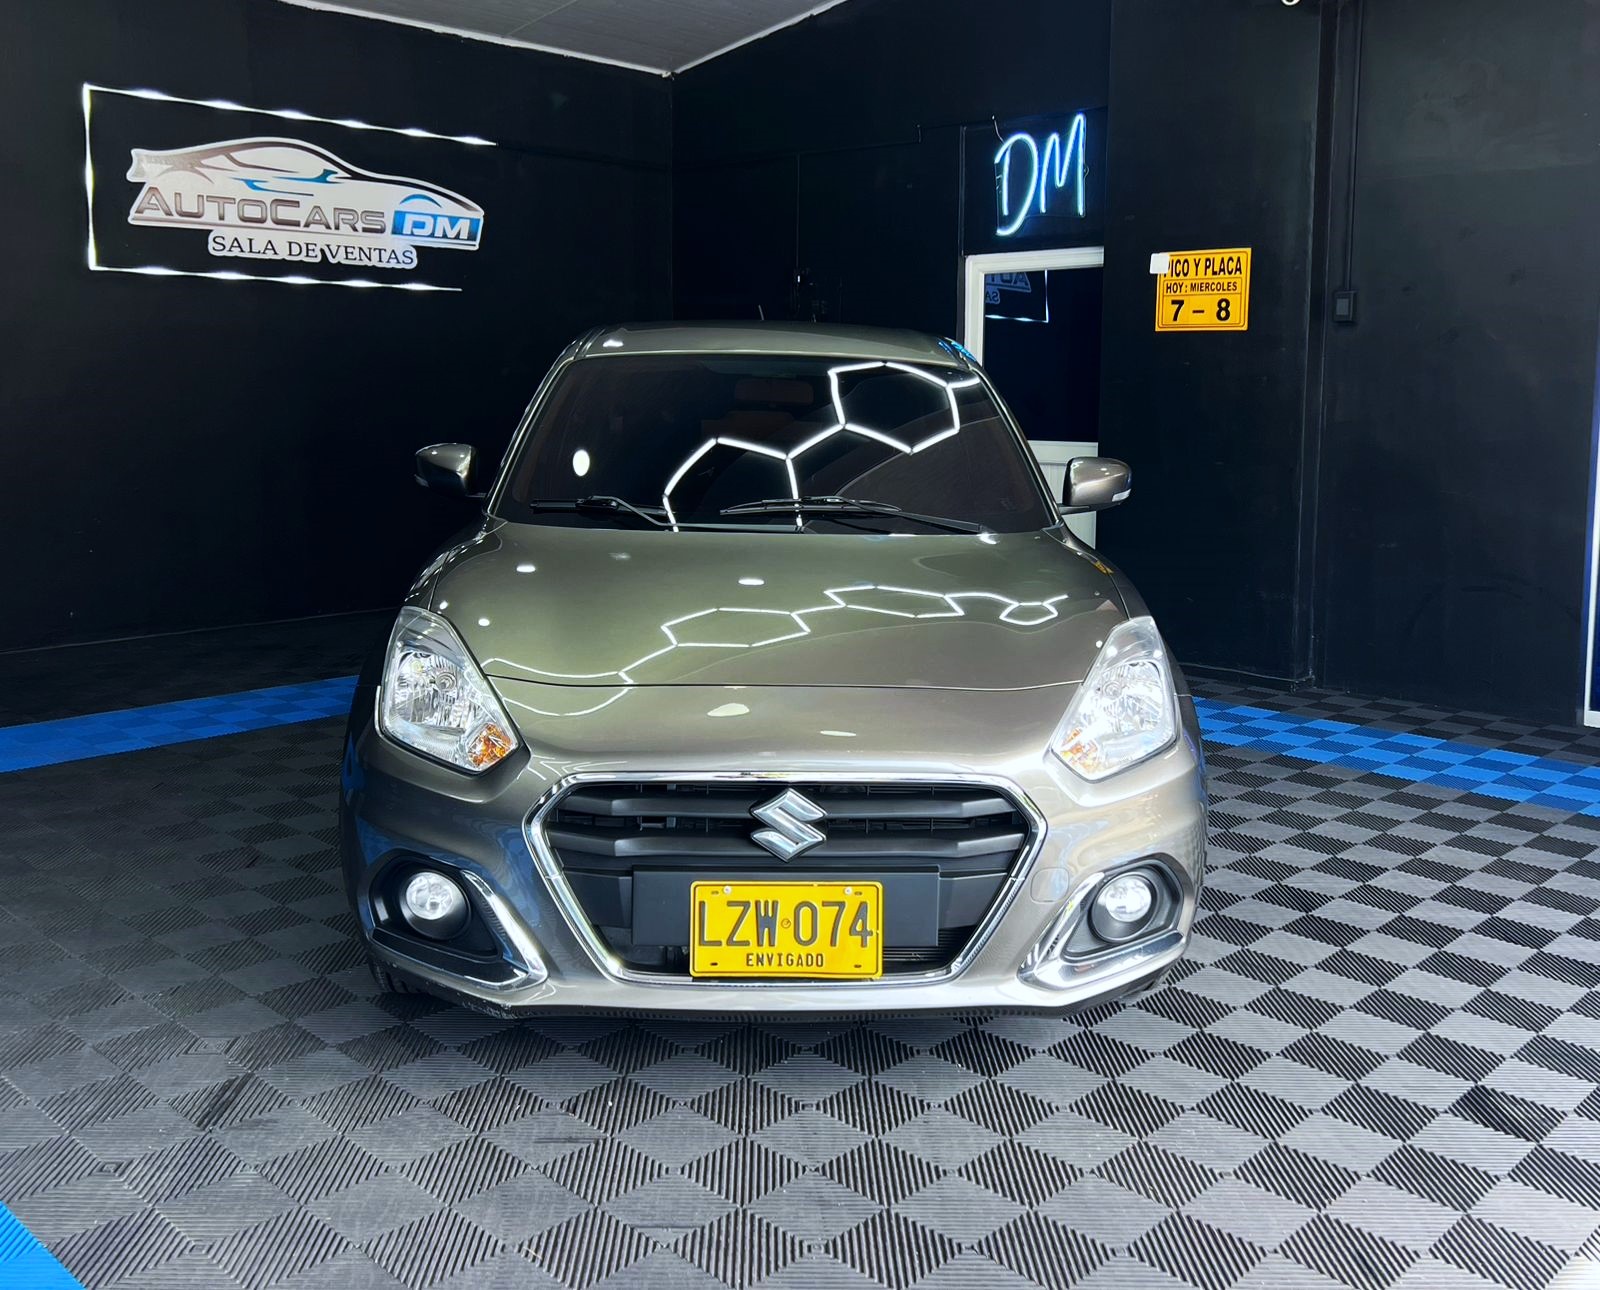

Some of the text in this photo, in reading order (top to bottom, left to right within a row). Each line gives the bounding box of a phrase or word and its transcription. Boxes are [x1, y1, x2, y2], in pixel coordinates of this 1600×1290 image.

[994, 112, 1086, 237] DM
[402, 213, 470, 240] DM
[212, 235, 414, 265] SALA DE VENTAS
[1193, 258, 1201, 276] Y
[1204, 256, 1242, 276] PLACA
[1190, 281, 1238, 292] MIERCOLES
[1171, 299, 1185, 322] 7
[1216, 298, 1231, 322] 8
[698, 900, 874, 949] LZW 074
[745, 952, 825, 968] ENVIGADO
